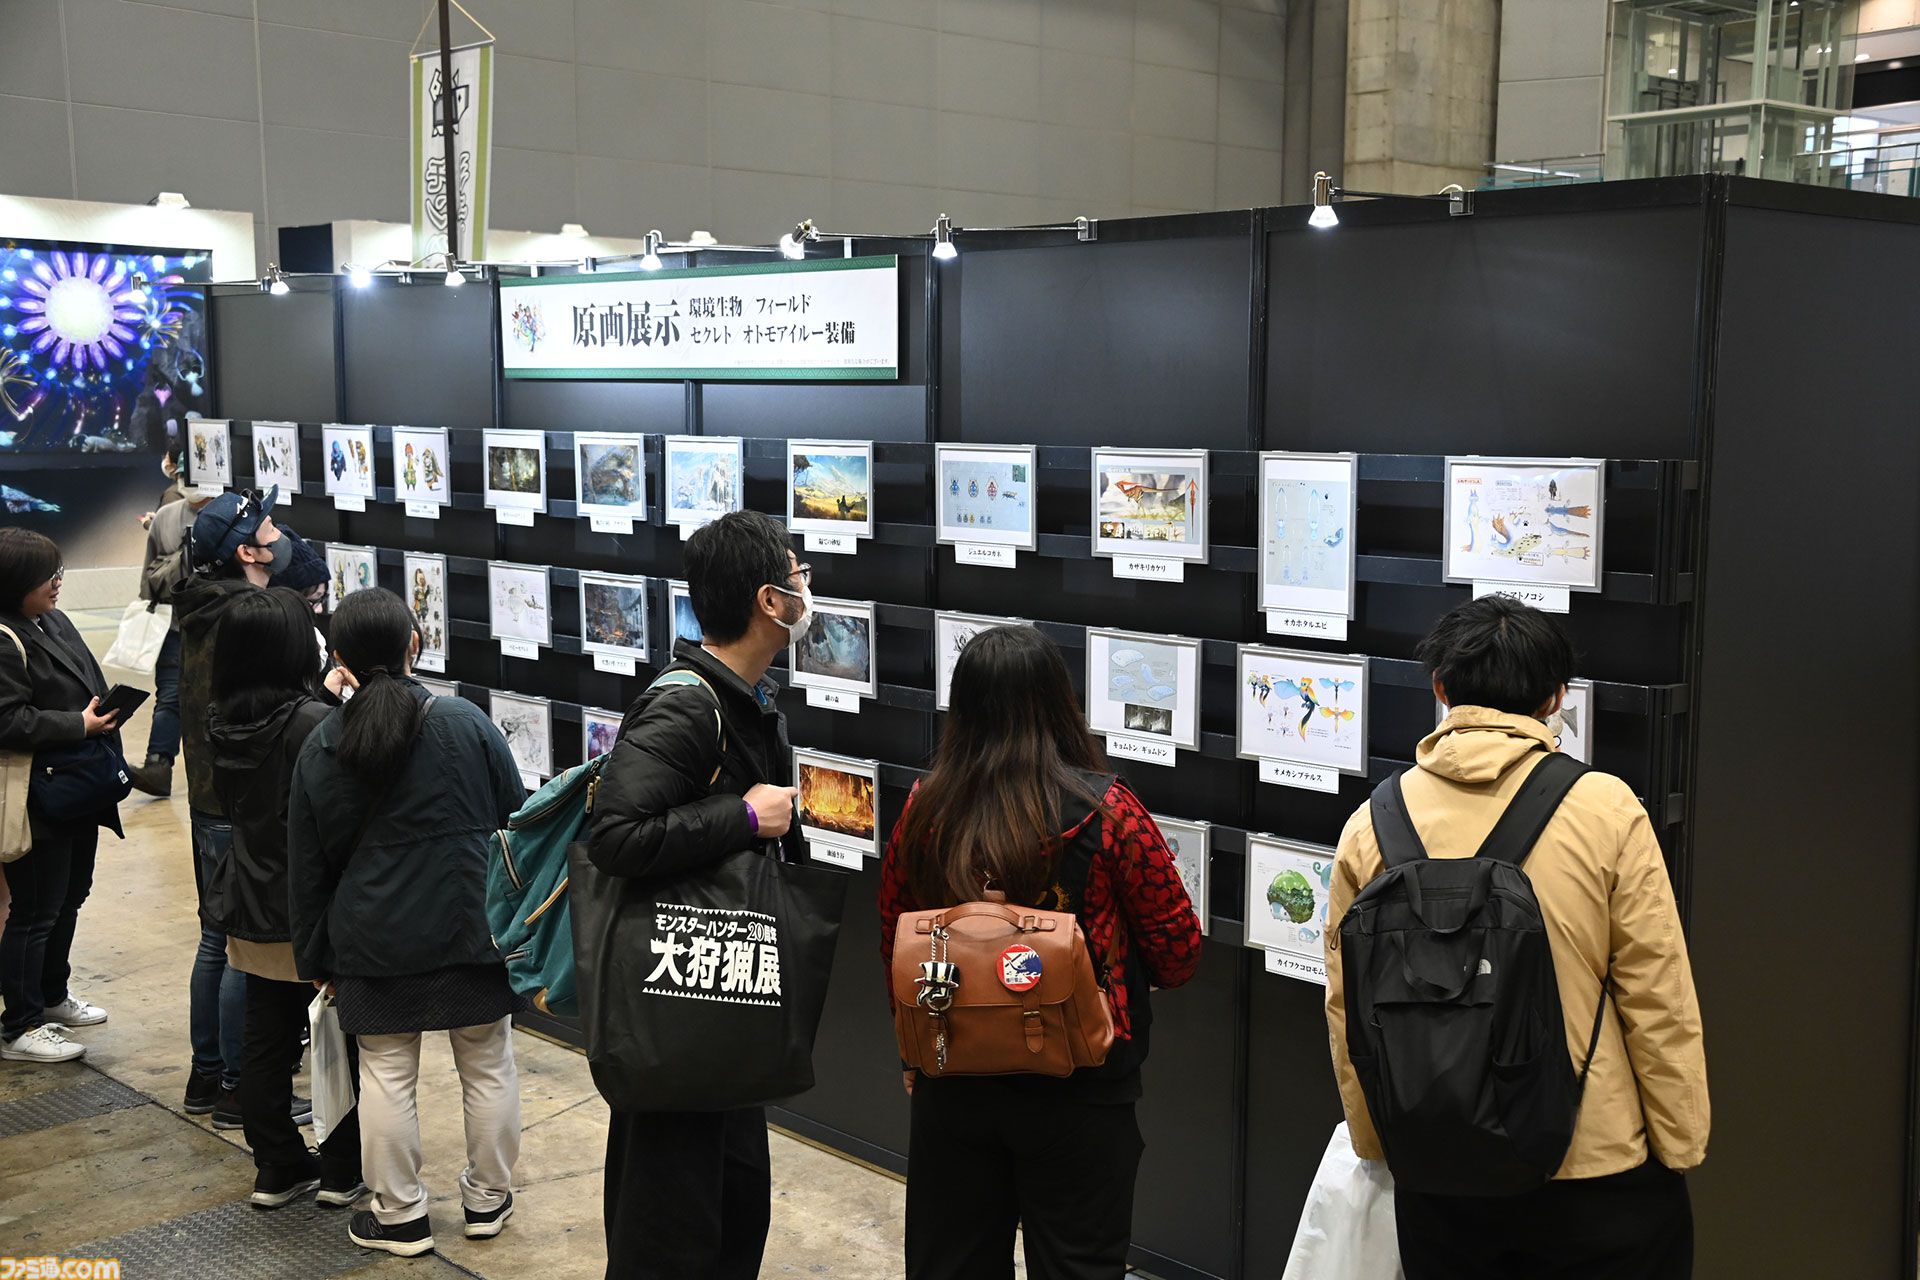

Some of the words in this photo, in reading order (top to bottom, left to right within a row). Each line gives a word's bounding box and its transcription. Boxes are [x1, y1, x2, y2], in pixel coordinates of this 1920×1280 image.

[689, 295, 742, 318] 環境生物
[756, 294, 811, 315] フィールド
[573, 299, 681, 348] 原画展示
[690, 325, 731, 344] セクレト
[743, 321, 855, 344] オトモアイルー装備
[656, 914, 777, 944] モンスターハンター20周年
[644, 932, 781, 996] 大狩猟展
